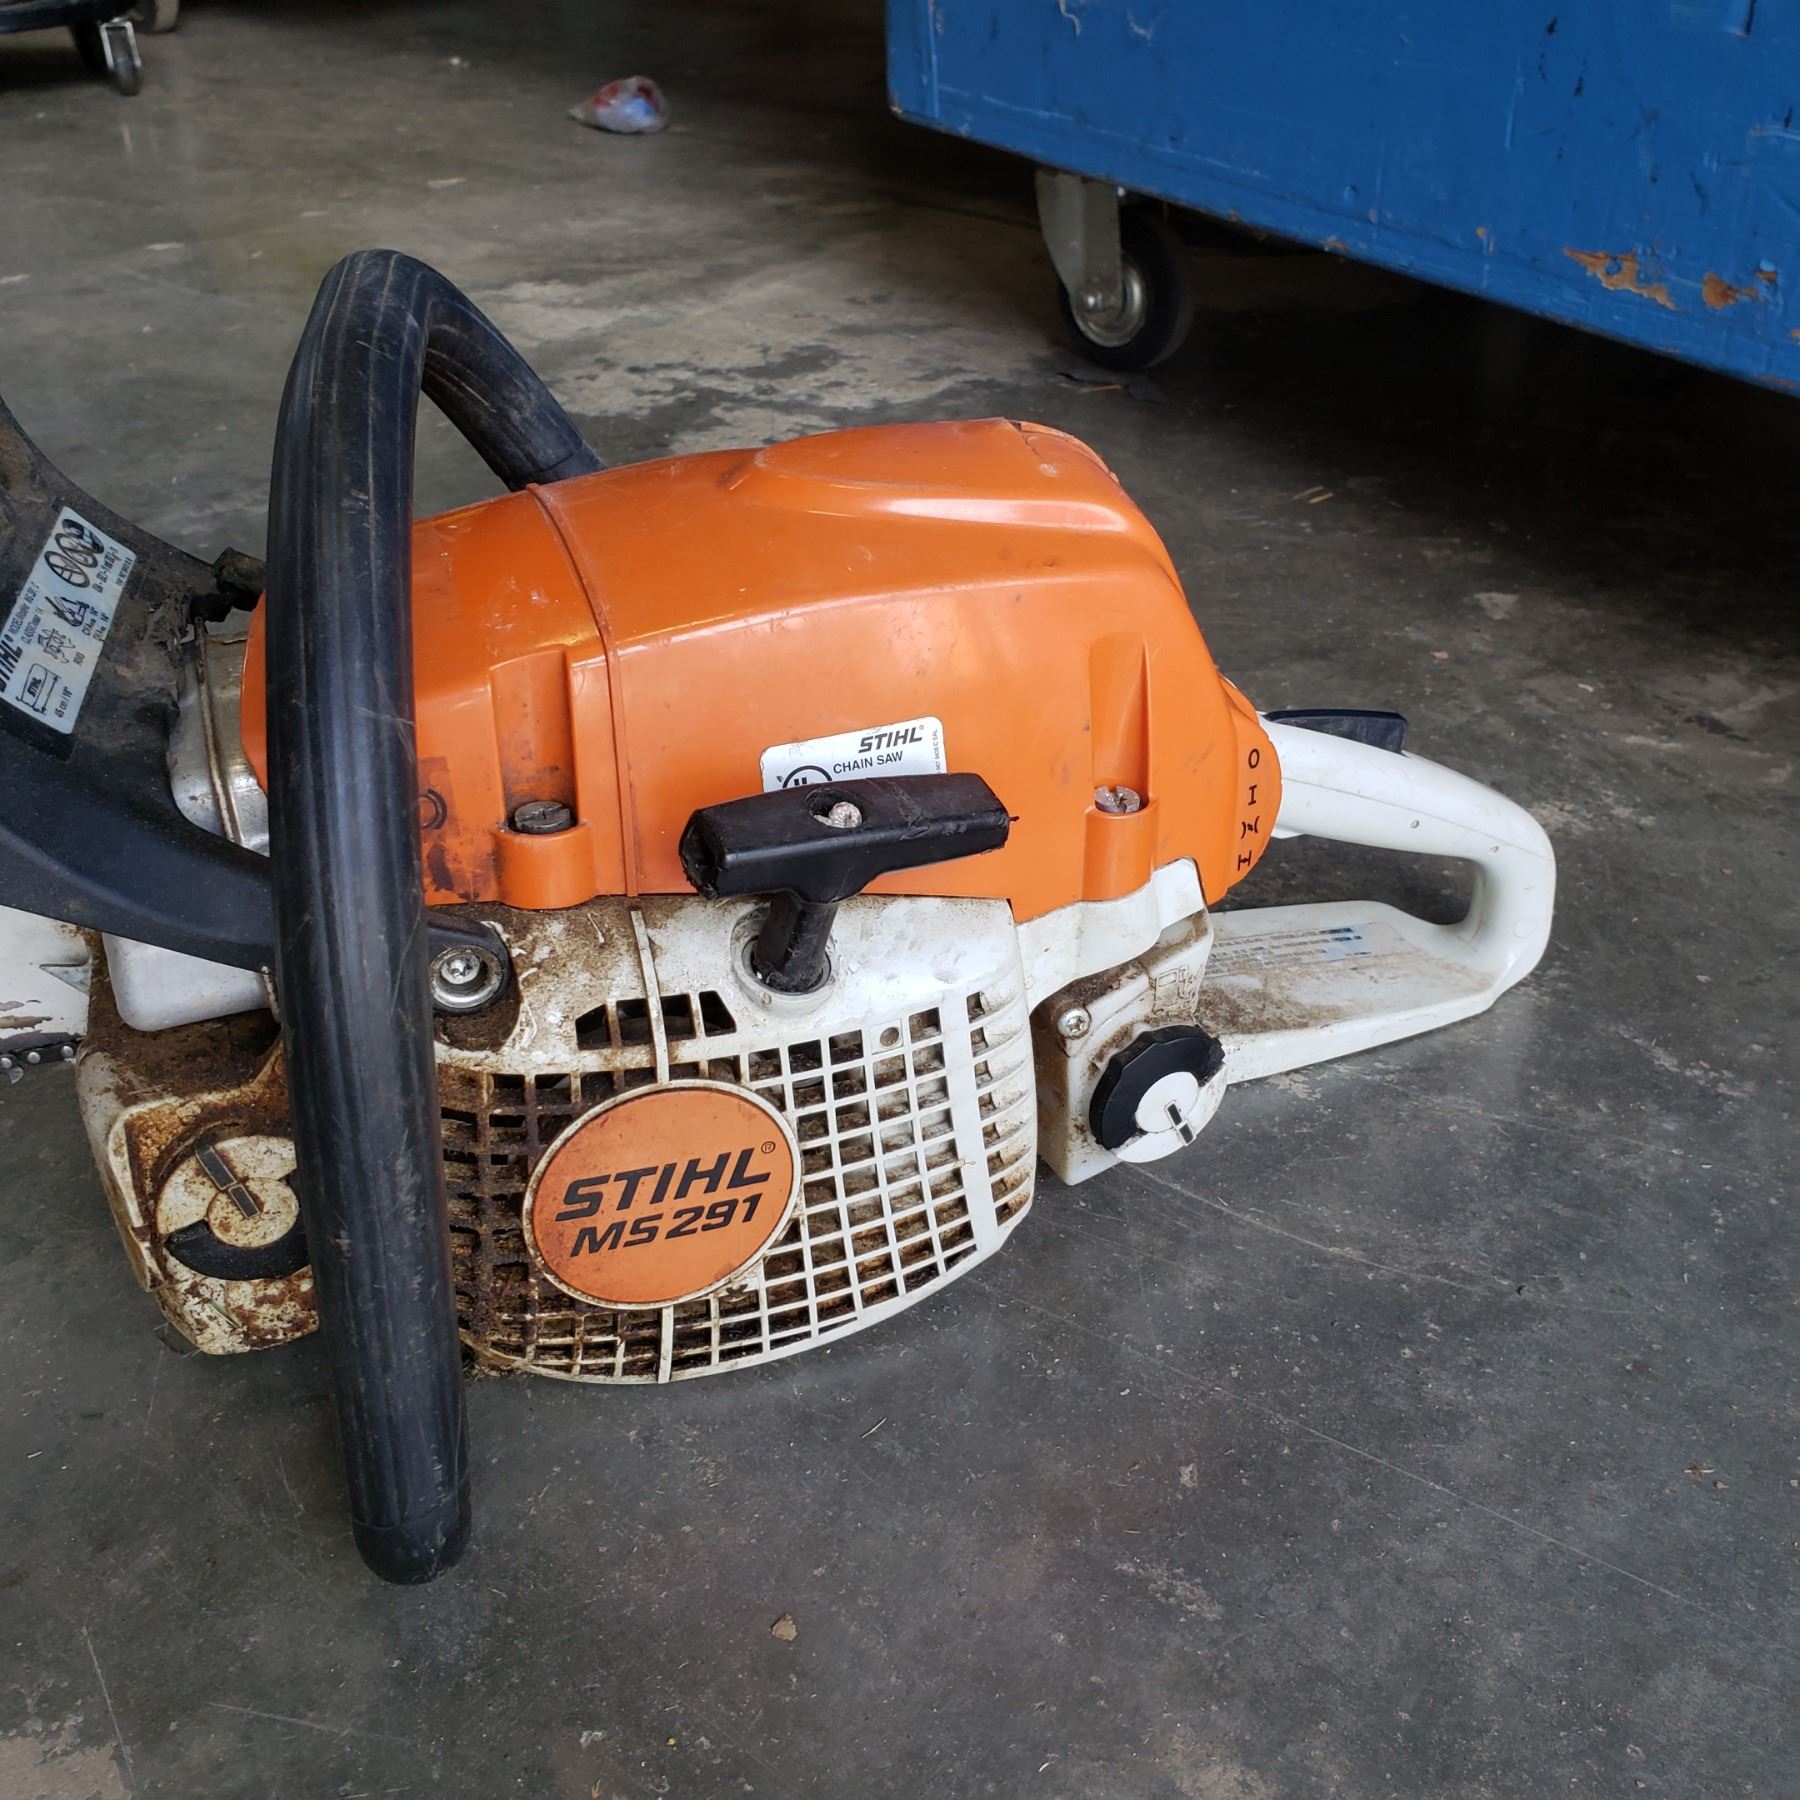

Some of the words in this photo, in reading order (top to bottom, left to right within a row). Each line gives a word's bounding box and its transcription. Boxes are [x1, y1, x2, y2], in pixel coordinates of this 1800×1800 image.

[833, 756, 873, 774] CHAIN
[877, 750, 903, 766] SAW
[570, 1213, 662, 1258] MS
[664, 1193, 763, 1240] 291
